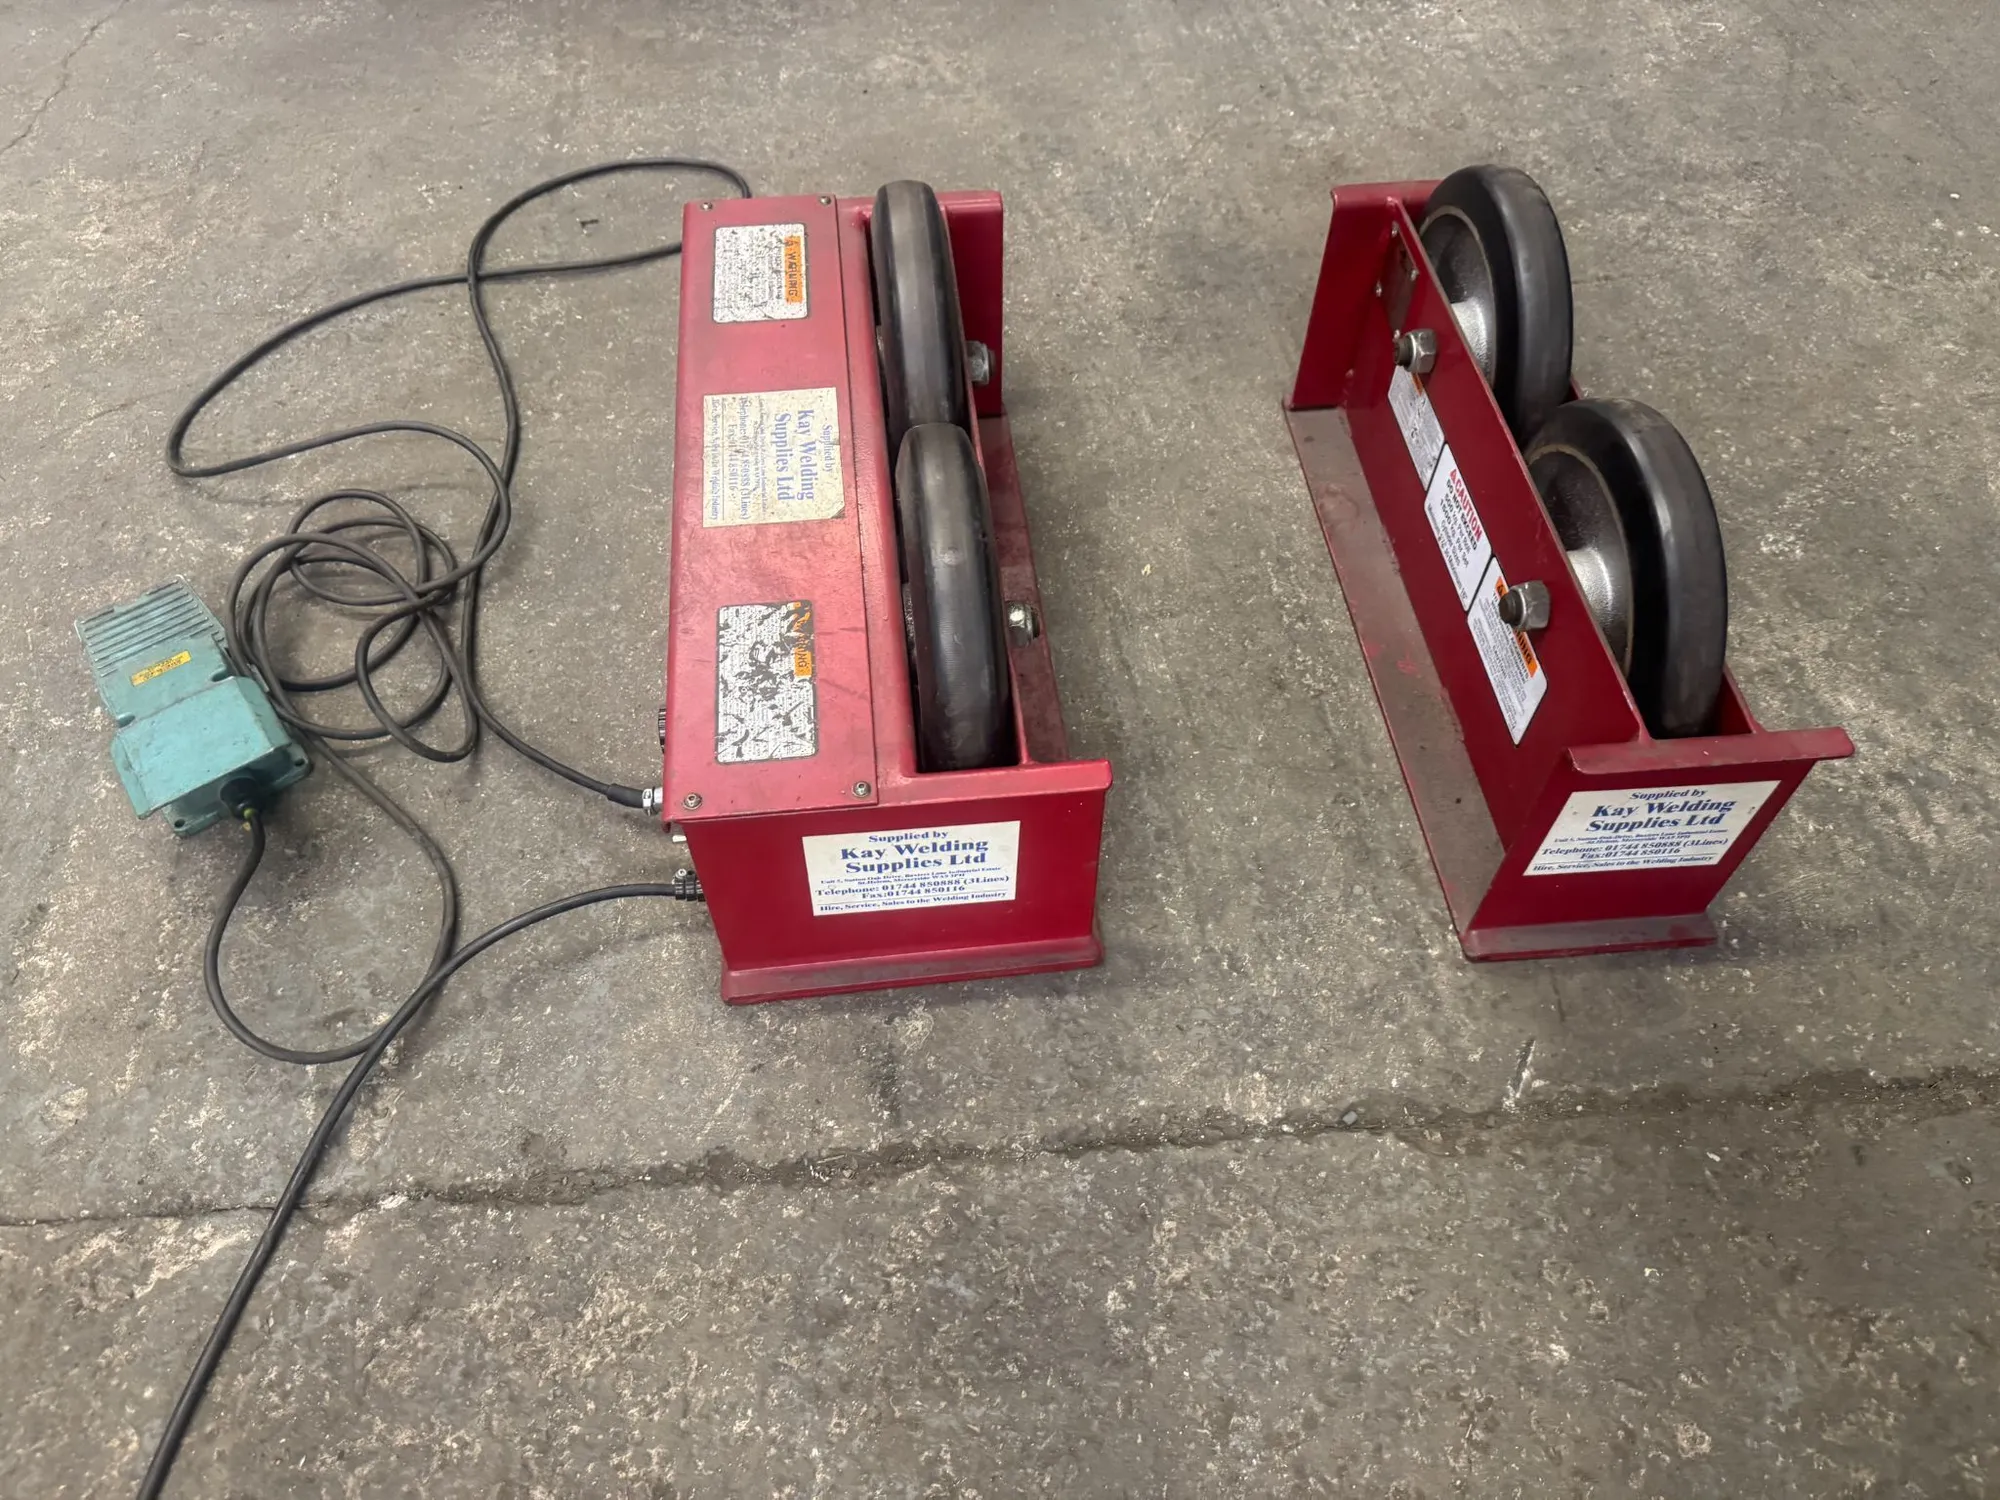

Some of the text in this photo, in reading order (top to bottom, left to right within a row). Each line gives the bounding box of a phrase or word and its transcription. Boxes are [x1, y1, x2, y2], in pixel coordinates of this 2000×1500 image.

[770, 413, 794, 500] Supplies Ltd
[794, 409, 818, 500] Kay Welding
[820, 424, 835, 472] Supplied by
[1447, 479, 1477, 550] DO NOT EXCEED
[1455, 479, 1482, 542] CAUTION
[1630, 789, 1706, 800] Supplied by
[1592, 799, 1737, 817] Kay Welding
[1586, 813, 1725, 833] Supplies Ltd
[869, 832, 929, 843] Supplied
[1542, 847, 1602, 855] Telephone:
[1605, 843, 1639, 851] 01744
[1683, 838, 1728, 847] (3Lines)
[841, 840, 988, 860] Kay Welding
[846, 852, 985, 873] Supplies Ltd
[816, 887, 878, 896] Telephone:
[920, 879, 960, 888] 850888
[963, 876, 1008, 885] (3Lines)
